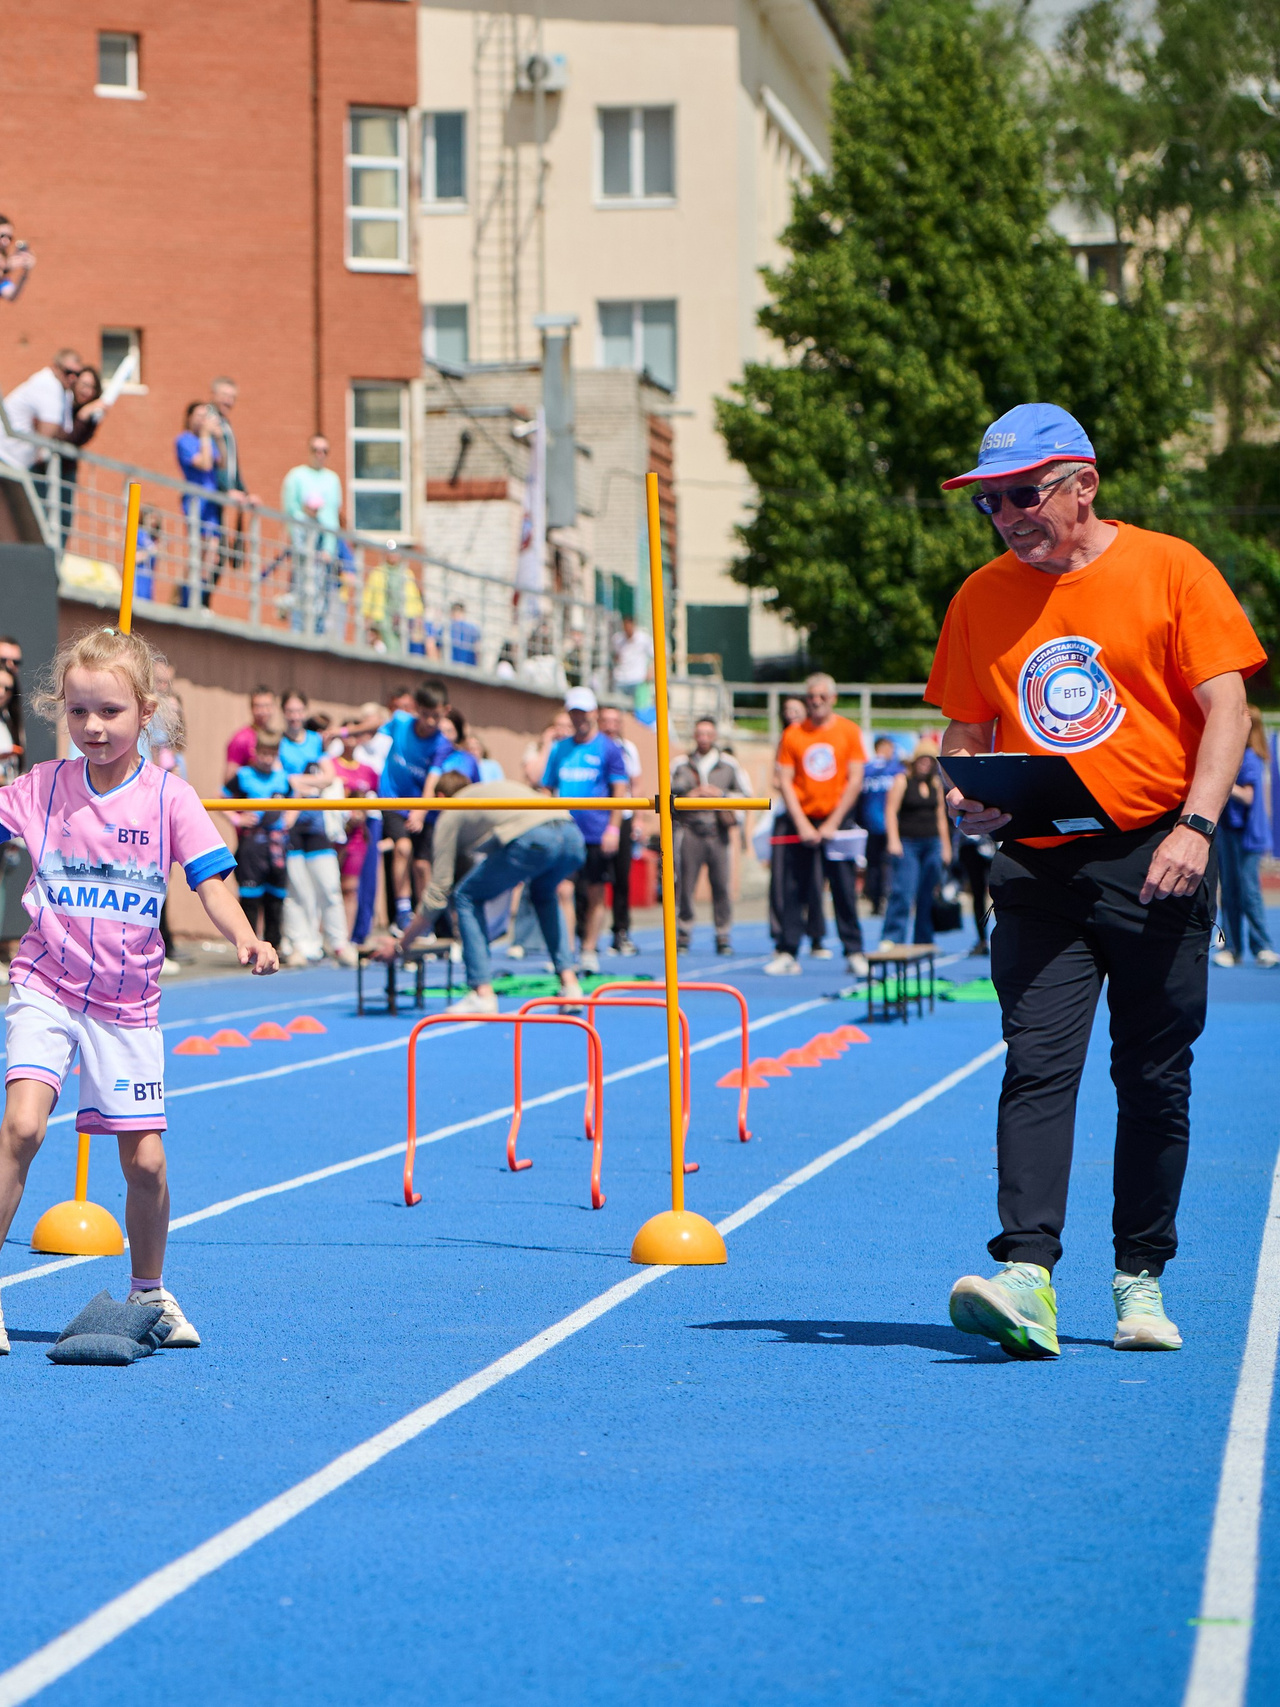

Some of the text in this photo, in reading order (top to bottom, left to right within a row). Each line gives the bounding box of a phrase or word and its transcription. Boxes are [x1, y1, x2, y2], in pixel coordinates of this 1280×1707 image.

[980, 432, 1017, 453] USSIA
[1036, 642, 1090, 662] СПАРТАКИАДА
[1039, 652, 1084, 674] ГРУППЫ ВТБ
[1064, 686, 1087, 699] ВТБ
[117, 828, 150, 846] ВТБ
